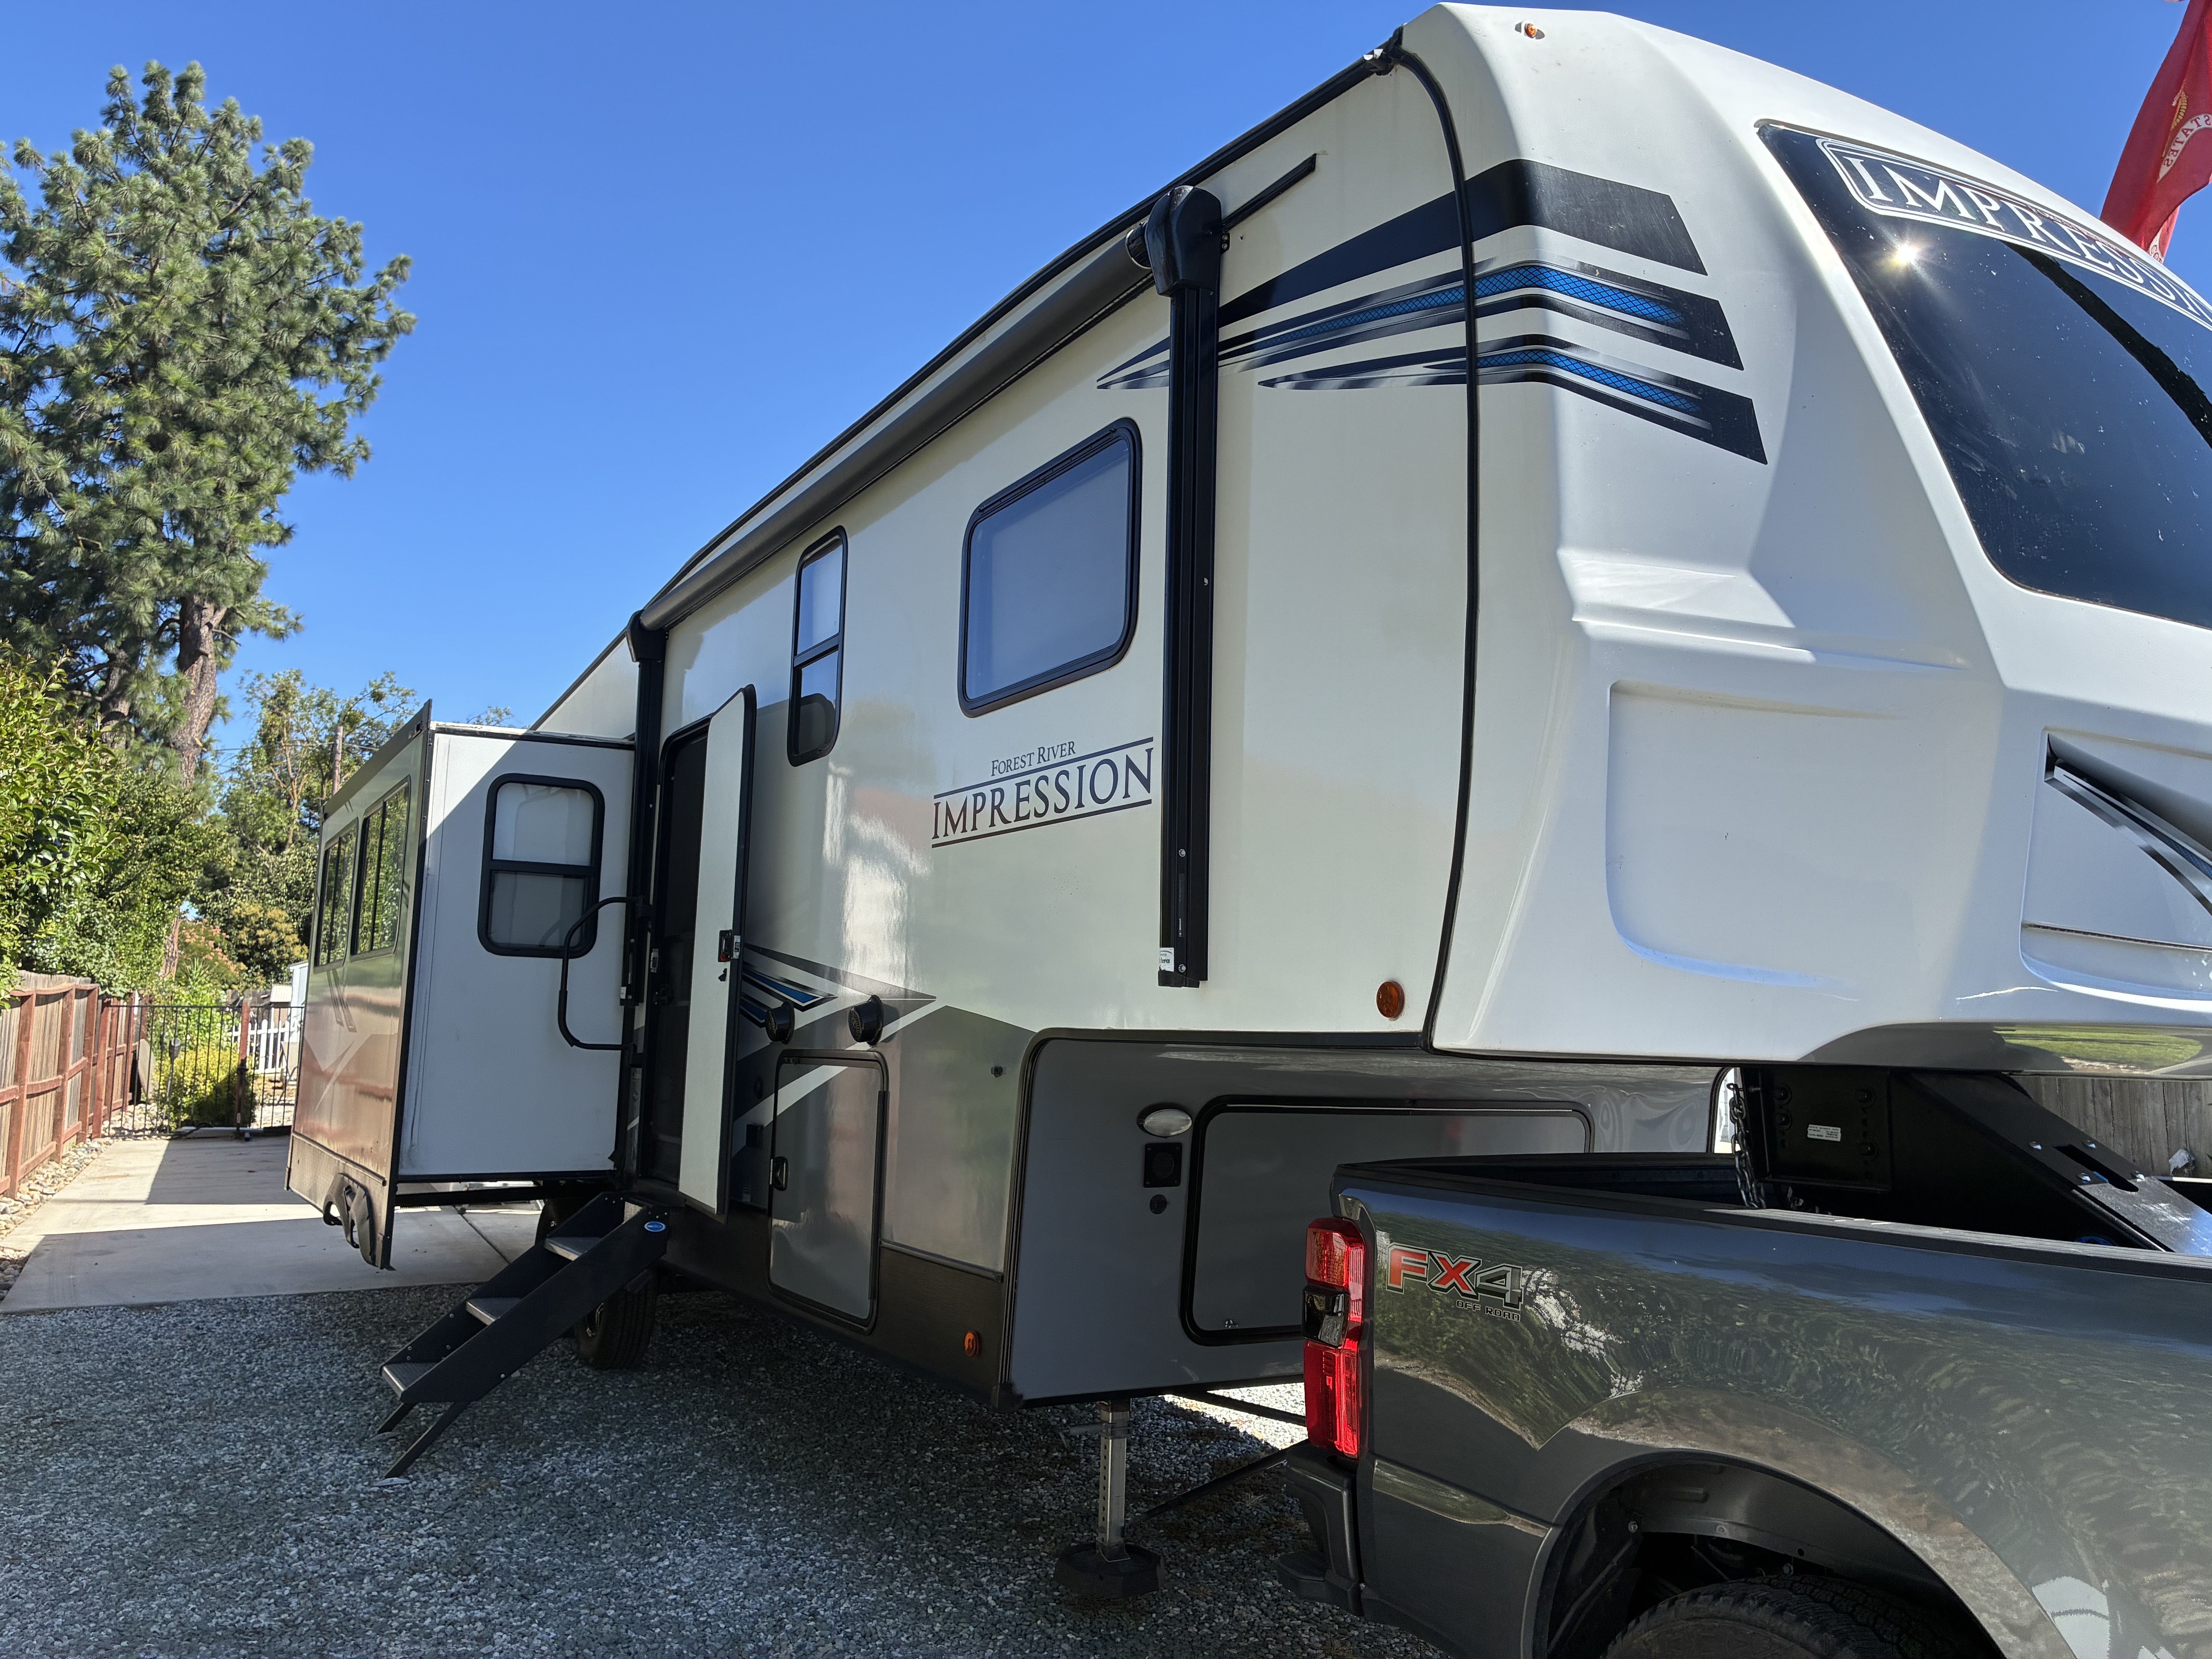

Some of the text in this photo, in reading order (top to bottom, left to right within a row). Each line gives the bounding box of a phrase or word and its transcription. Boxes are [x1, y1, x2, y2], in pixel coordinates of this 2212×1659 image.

[991, 741, 1076, 776] FOREST RIVER
[932, 747, 1154, 840] IMPRESSION
[1386, 1242, 1524, 1311] FX4
[1456, 1300, 1520, 1322] OFF ROAD
